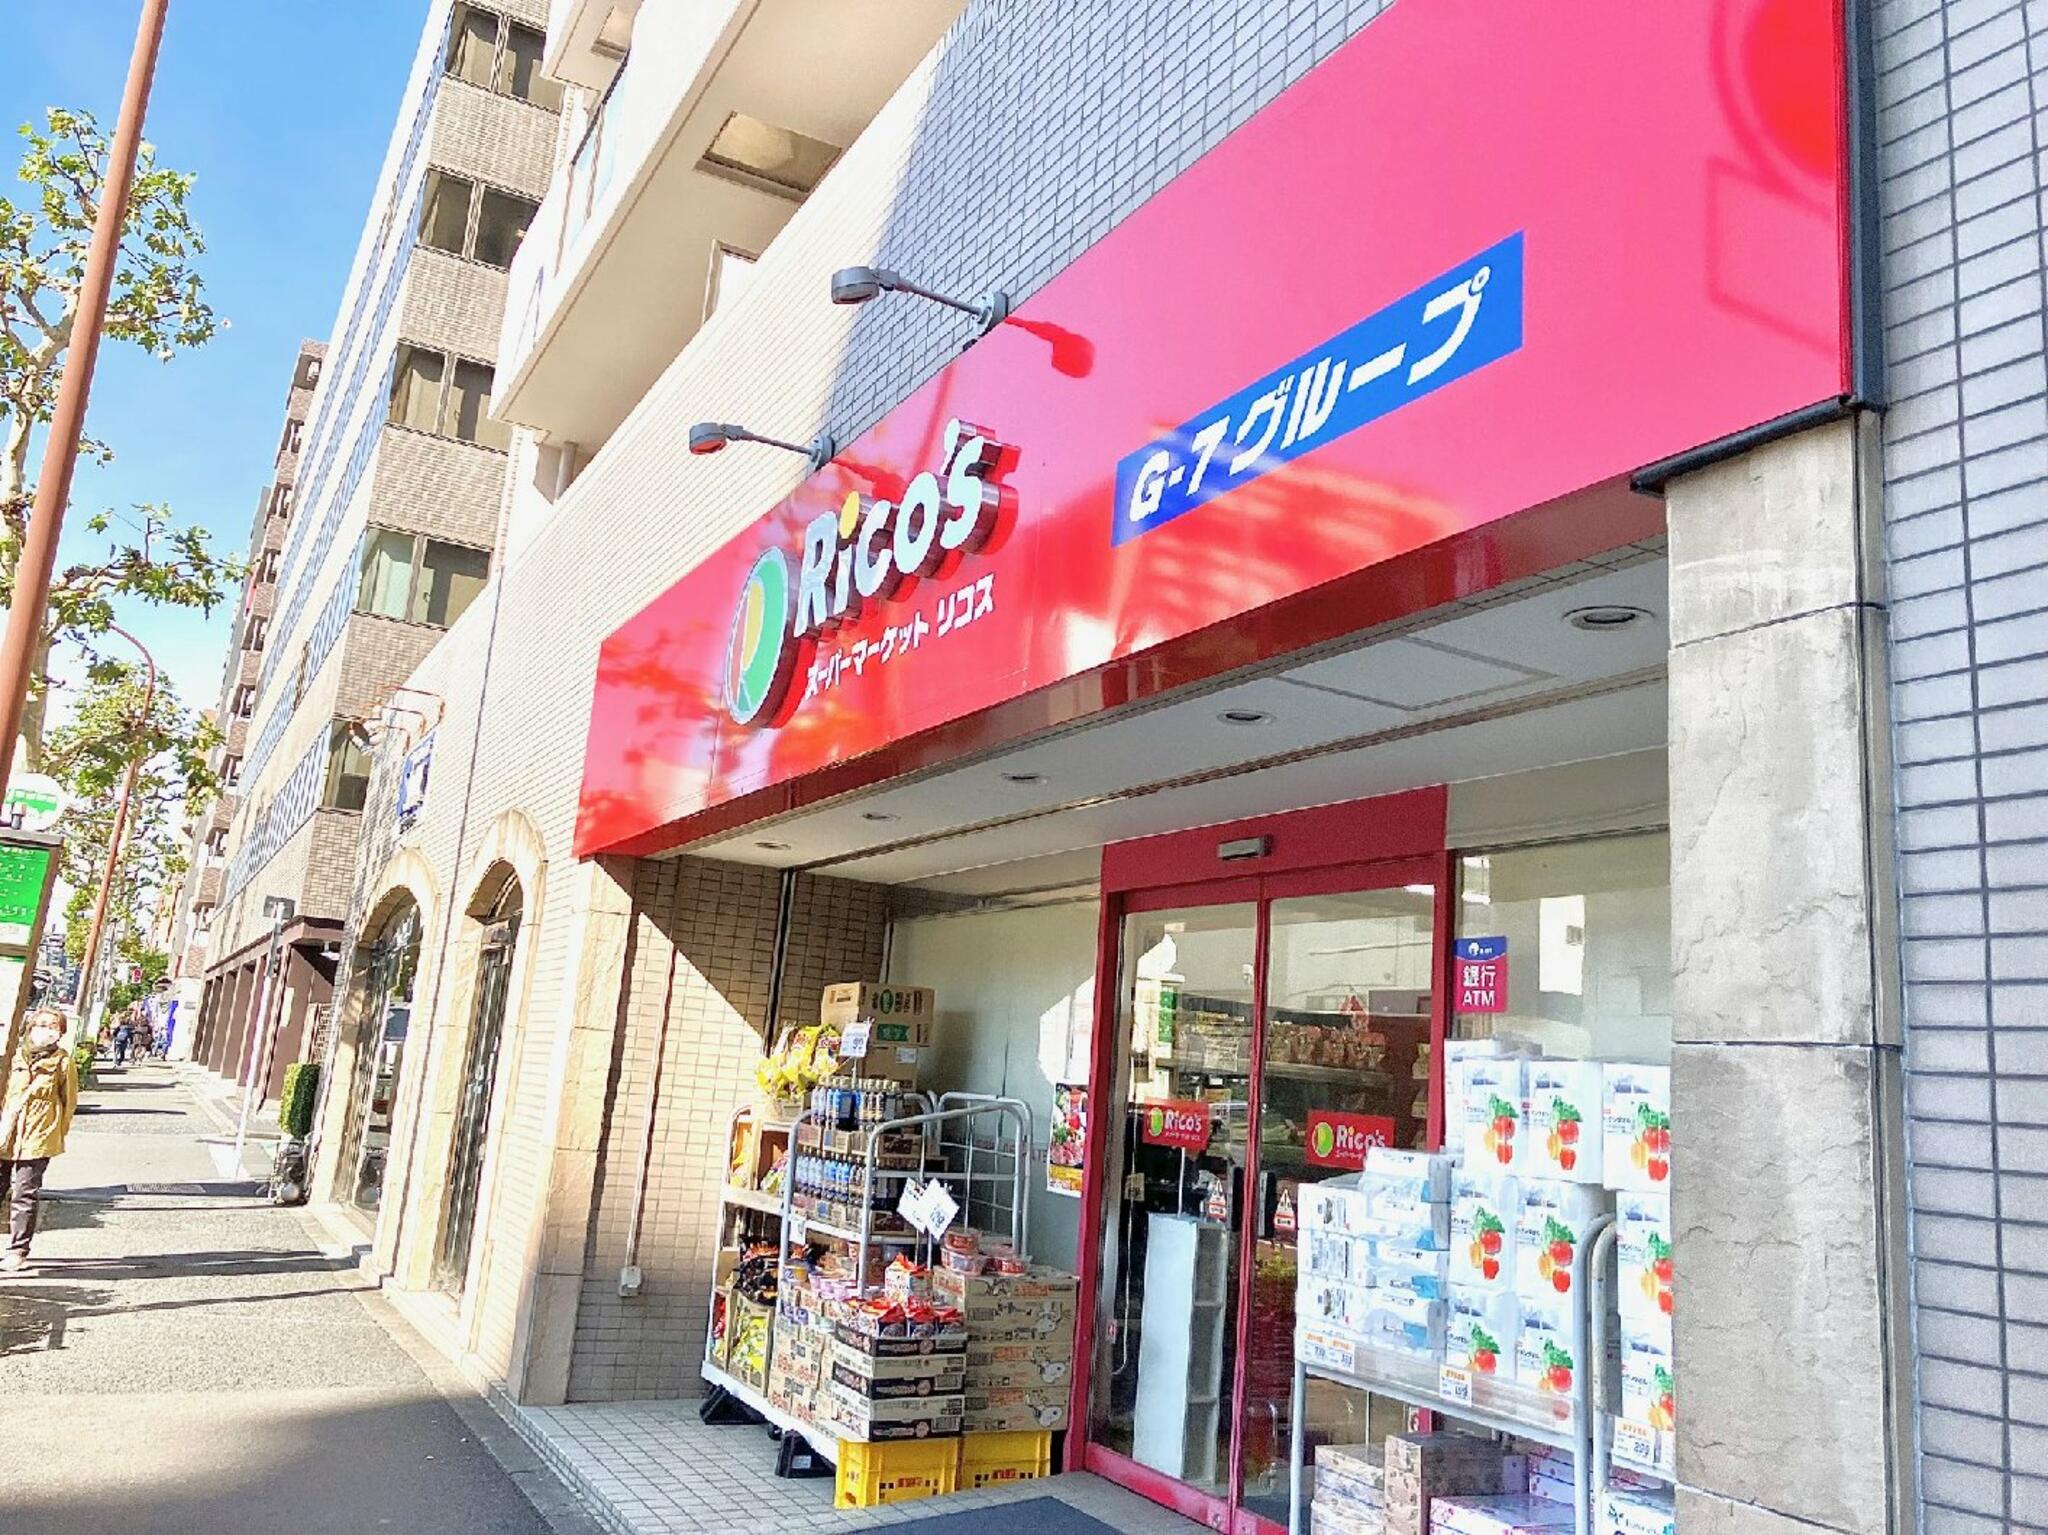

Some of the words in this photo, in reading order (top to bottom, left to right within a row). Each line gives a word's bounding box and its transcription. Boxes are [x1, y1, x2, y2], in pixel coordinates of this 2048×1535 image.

[1129, 266, 1492, 522] G-7グループ
[794, 417, 988, 638] Rico's
[804, 611, 929, 701] スーパーマーケット
[936, 574, 995, 638] リコス
[1462, 965, 1496, 987] 銀行
[1462, 990, 1496, 1007] ATM
[1164, 1108, 1202, 1133] Rico's
